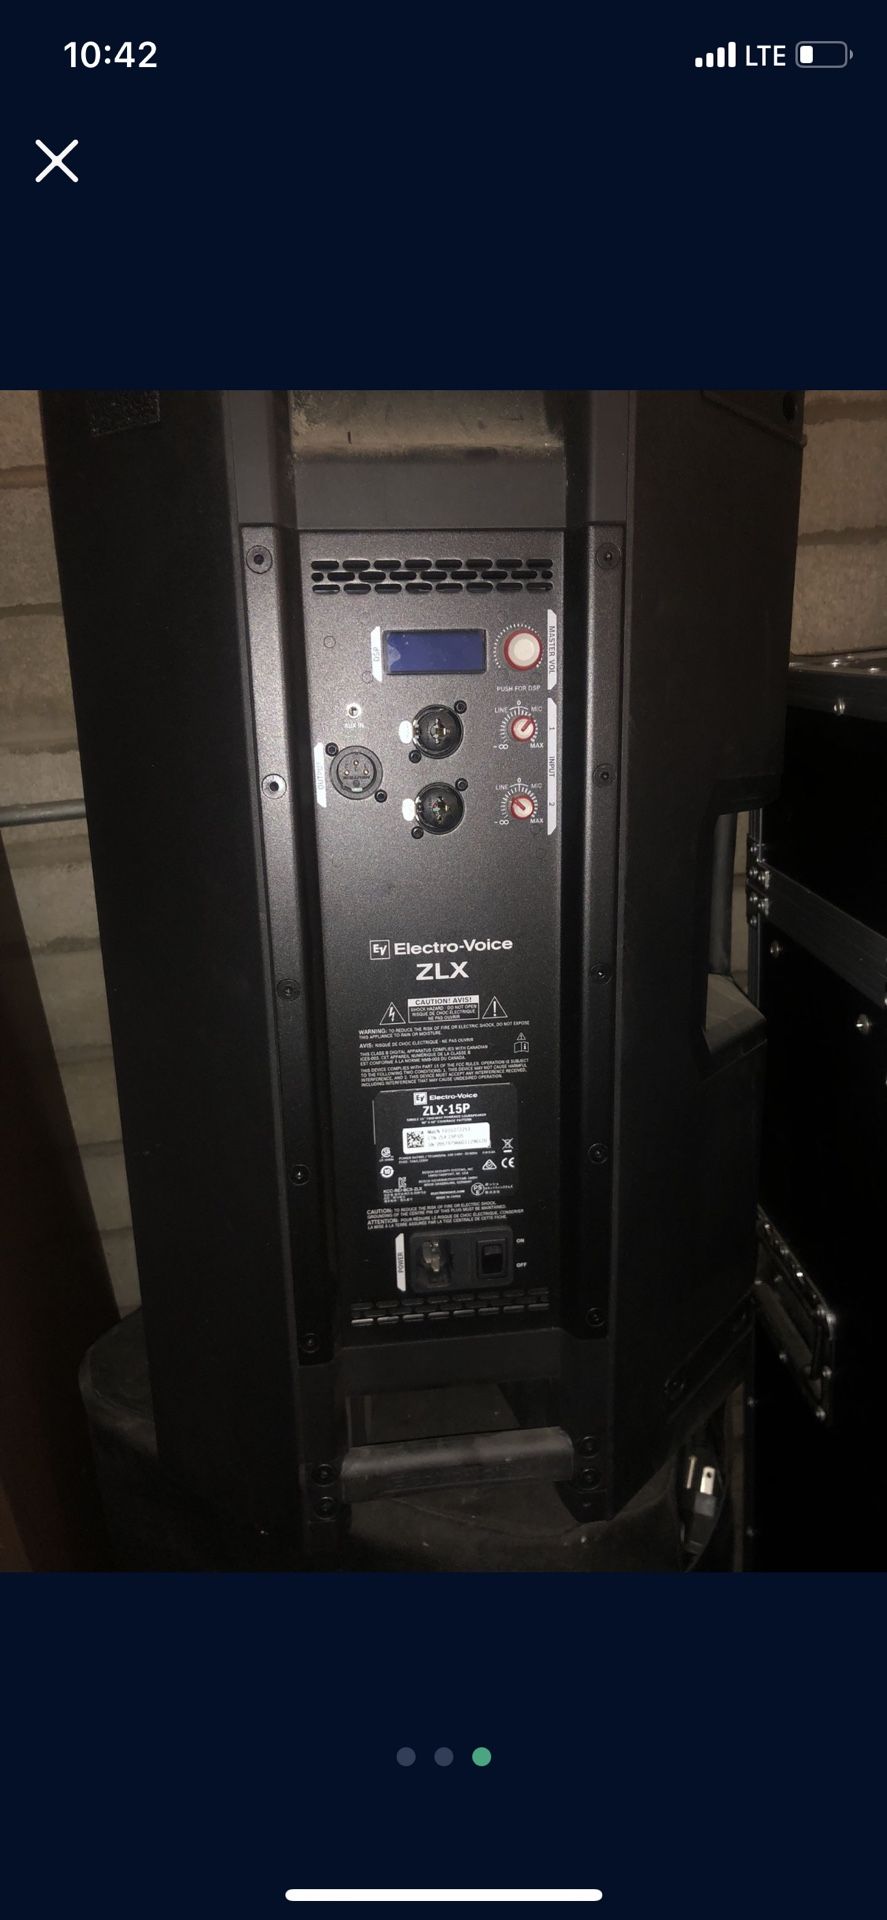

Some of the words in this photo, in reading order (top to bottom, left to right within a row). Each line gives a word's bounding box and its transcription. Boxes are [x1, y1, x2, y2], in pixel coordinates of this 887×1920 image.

[394, 938, 513, 955] Electro-Voice
[415, 961, 470, 981] ZLX
[429, 1093, 478, 1102] Electro-Voice
[422, 1103, 471, 1116] ZLX-15P
